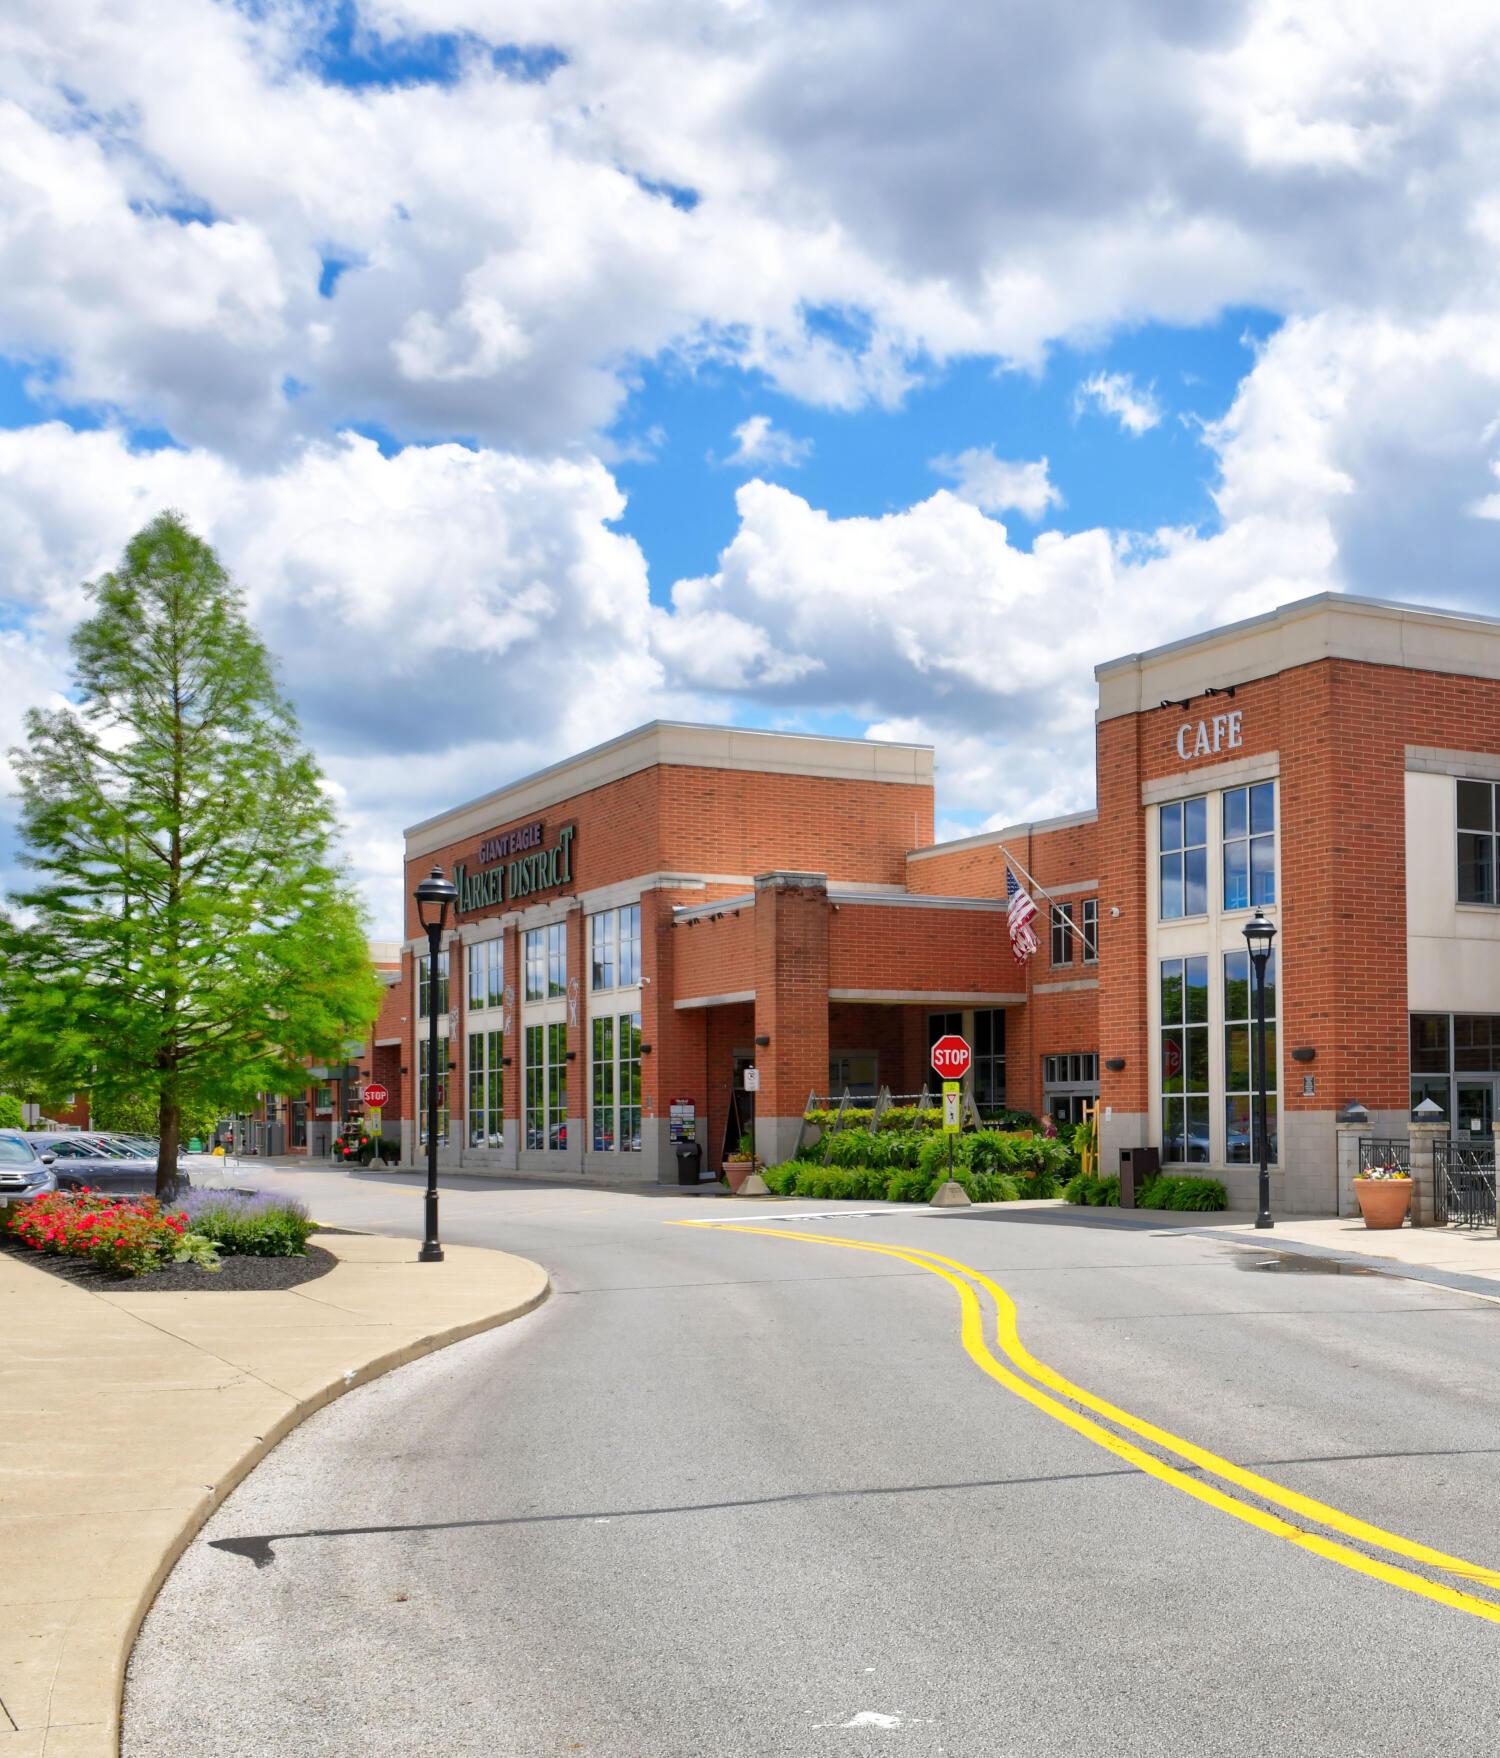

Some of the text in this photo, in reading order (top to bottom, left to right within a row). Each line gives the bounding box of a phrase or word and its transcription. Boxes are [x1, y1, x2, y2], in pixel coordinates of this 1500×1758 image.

[1177, 711, 1243, 760] CAFE
[480, 824, 541, 863] GIANT EAGLE
[453, 825, 574, 913] MARKET DISTRICT
[934, 1049, 969, 1065] STOP
[364, 1091, 387, 1101] STOP
